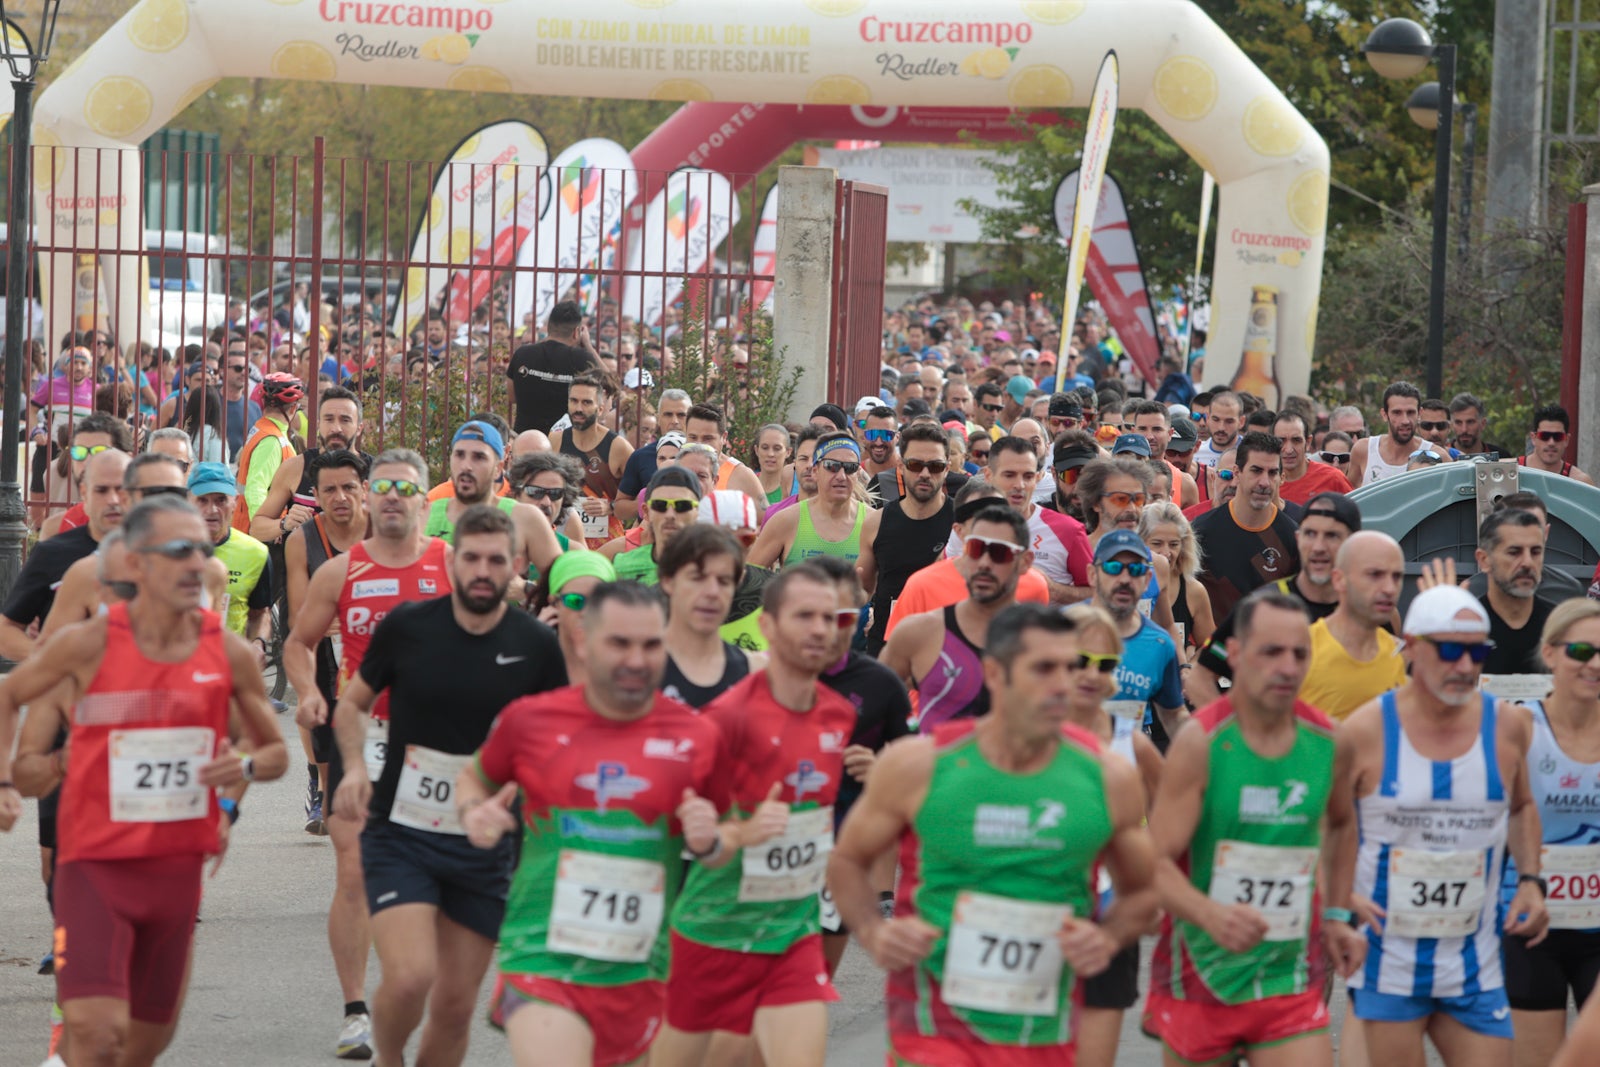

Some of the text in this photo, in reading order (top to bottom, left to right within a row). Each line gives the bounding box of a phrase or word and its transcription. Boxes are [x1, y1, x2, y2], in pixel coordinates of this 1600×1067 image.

[318, 0, 494, 33] Cruzcampo
[859, 15, 1033, 47] Cruzcampo
[536, 17, 573, 40] CON
[578, 20, 631, 43] ZUMO
[636, 22, 717, 46] NATURAL
[723, 24, 746, 46] DE
[335, 32, 421, 62] Radler
[536, 43, 811, 74] DOBLEMENTE REFRESCANTE
[876, 52, 960, 81] Radler
[1231, 228, 1313, 250] Cruzcampo
[135, 761, 190, 789] 275
[766, 842, 817, 872] 602
[1235, 878, 1296, 907] 372
[1410, 880, 1468, 907] 347
[1548, 874, 1600, 900] 209
[580, 888, 642, 923] 718
[978, 934, 1044, 971] 707
